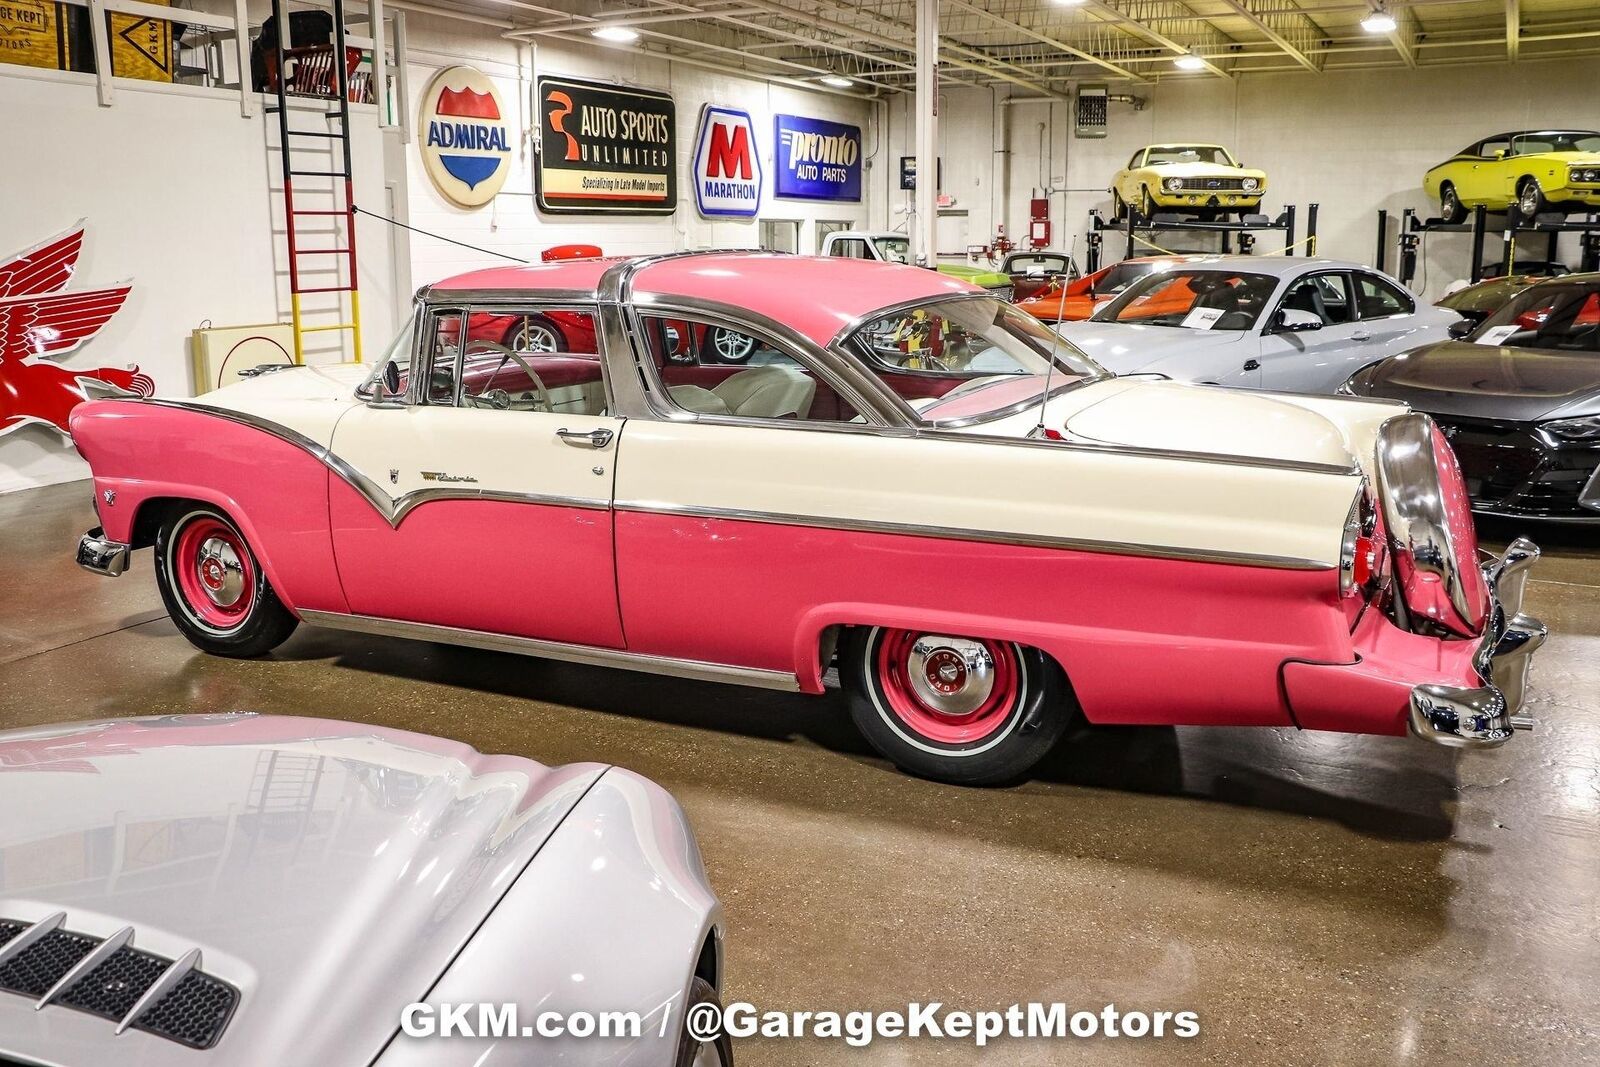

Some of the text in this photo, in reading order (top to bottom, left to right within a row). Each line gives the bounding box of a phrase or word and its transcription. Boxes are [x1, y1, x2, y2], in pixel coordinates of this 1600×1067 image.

[16, 9, 41, 24] KEPT
[149, 21, 158, 54] GKM
[428, 121, 511, 151] ADMIRAL
[581, 105, 669, 143] AUTO SPORTS
[581, 144, 668, 167] UNLIMITED
[706, 122, 752, 180] M
[789, 130, 858, 170] pronto
[582, 176, 613, 191] Specializing
[620, 179, 631, 190] Late
[632, 179, 646, 190] Model
[647, 180, 665, 192] Imports
[797, 165, 847, 183] AUTO PARTS
[705, 181, 755, 199] MARATHON
